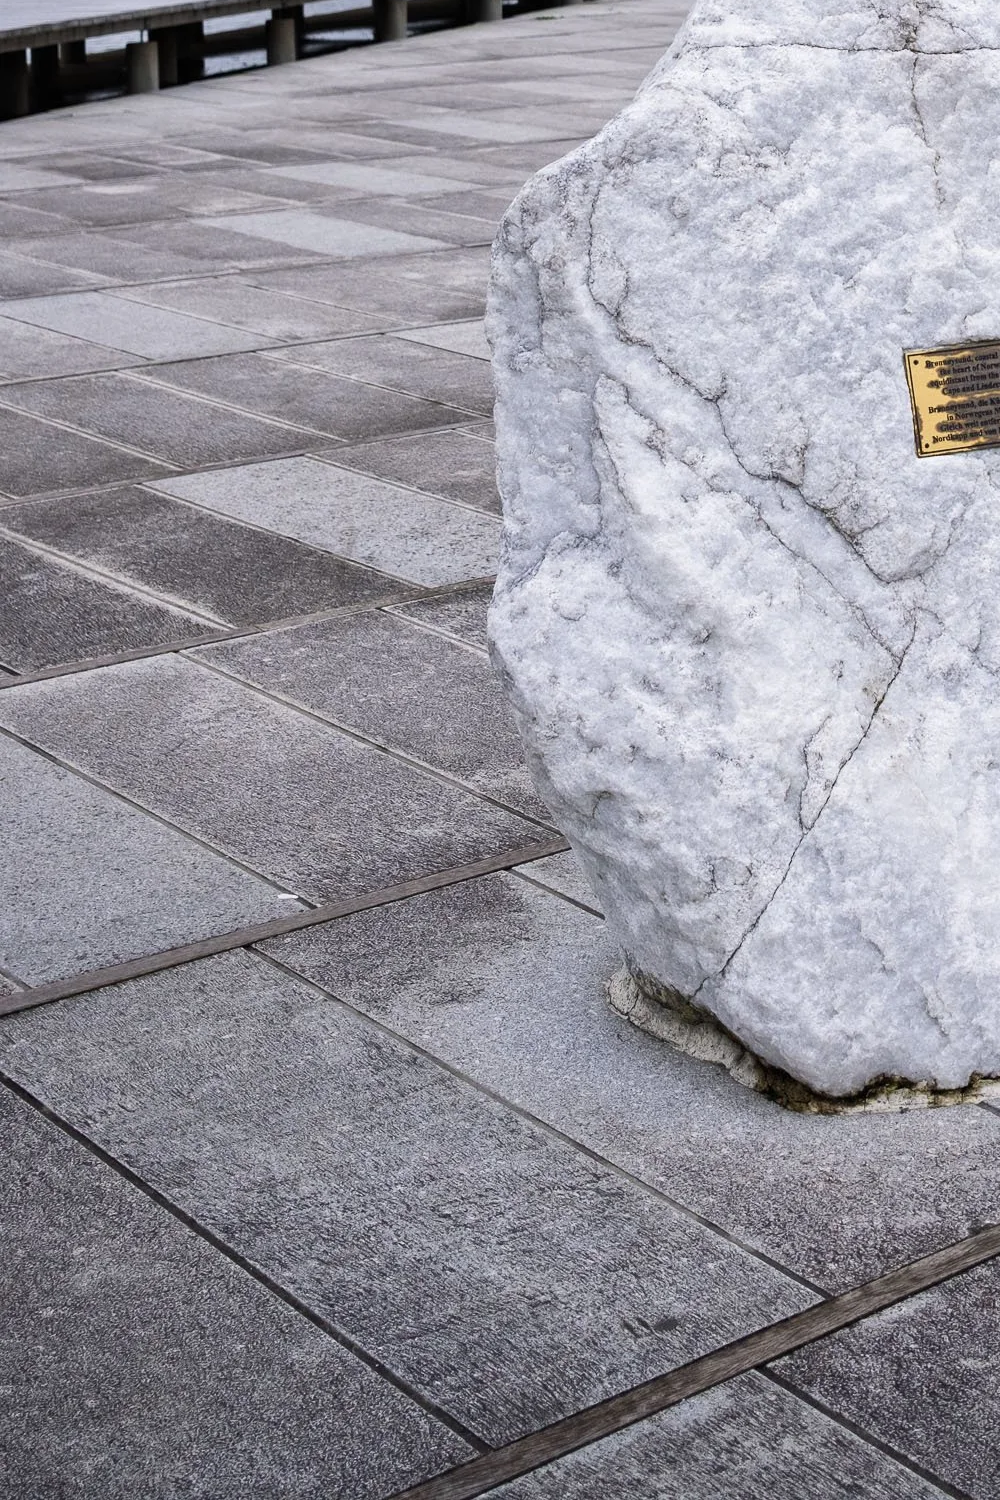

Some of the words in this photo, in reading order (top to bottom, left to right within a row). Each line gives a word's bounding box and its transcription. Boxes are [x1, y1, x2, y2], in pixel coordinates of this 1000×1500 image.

[953, 365, 971, 374] heart
[972, 363, 980, 371] of
[970, 372, 987, 381] from
[989, 370, 999, 378] the
